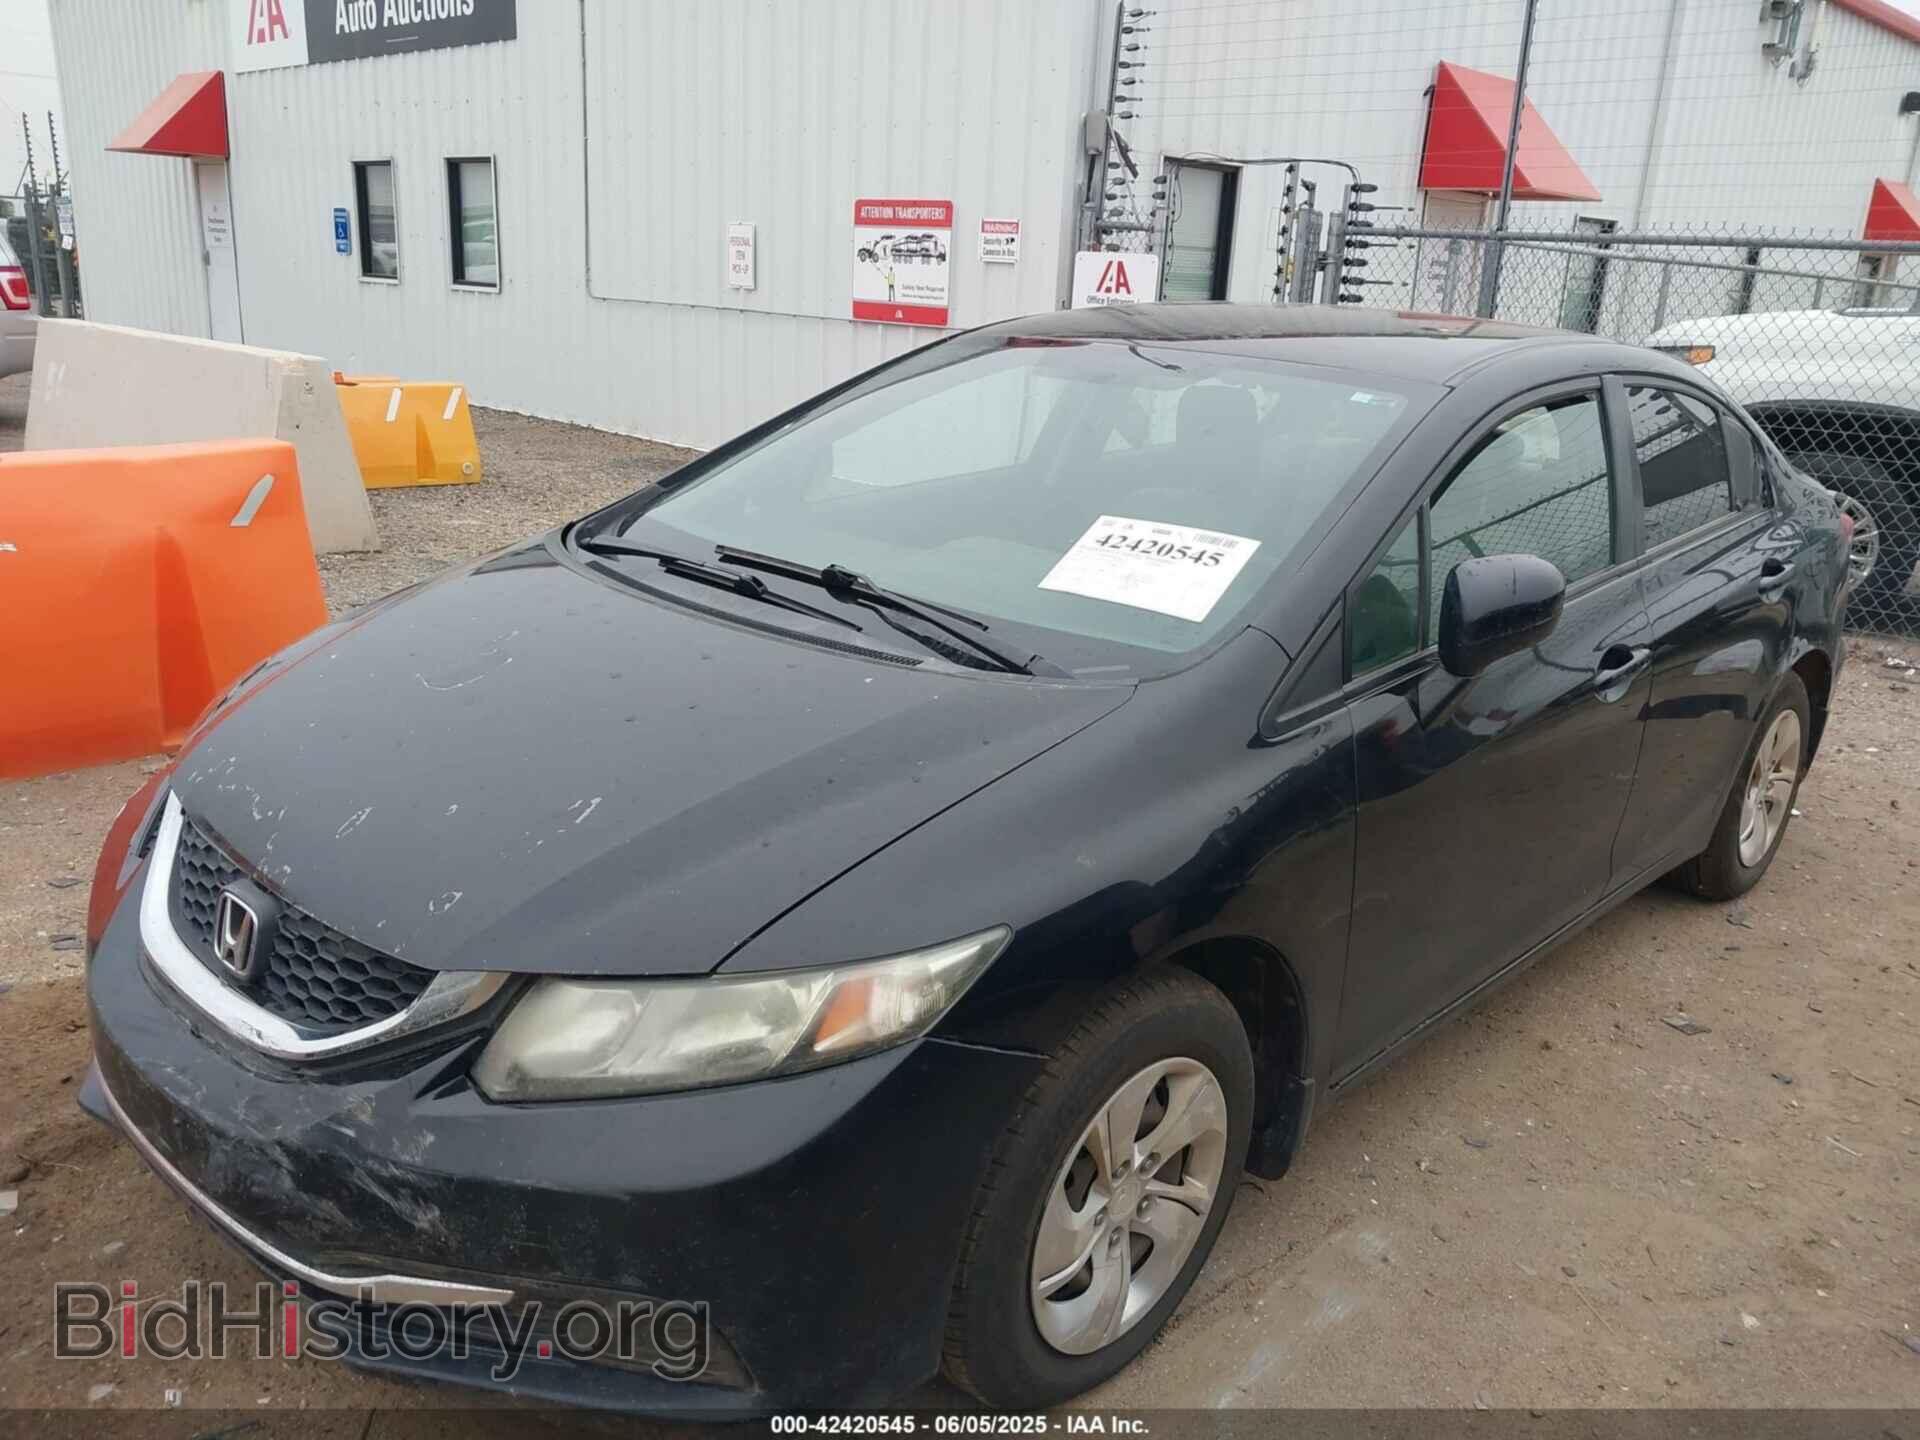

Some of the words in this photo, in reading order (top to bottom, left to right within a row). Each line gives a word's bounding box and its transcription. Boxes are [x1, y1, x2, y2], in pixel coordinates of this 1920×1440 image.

[335, 0, 377, 35] Auto
[383, 0, 474, 27] Auctions
[860, 206, 894, 219] ATTENTION
[895, 206, 946, 220] TRANSPORTERS!
[983, 222, 1017, 233] WARNING
[1086, 295, 1105, 304] Office
[1096, 533, 1225, 567] 42420545
